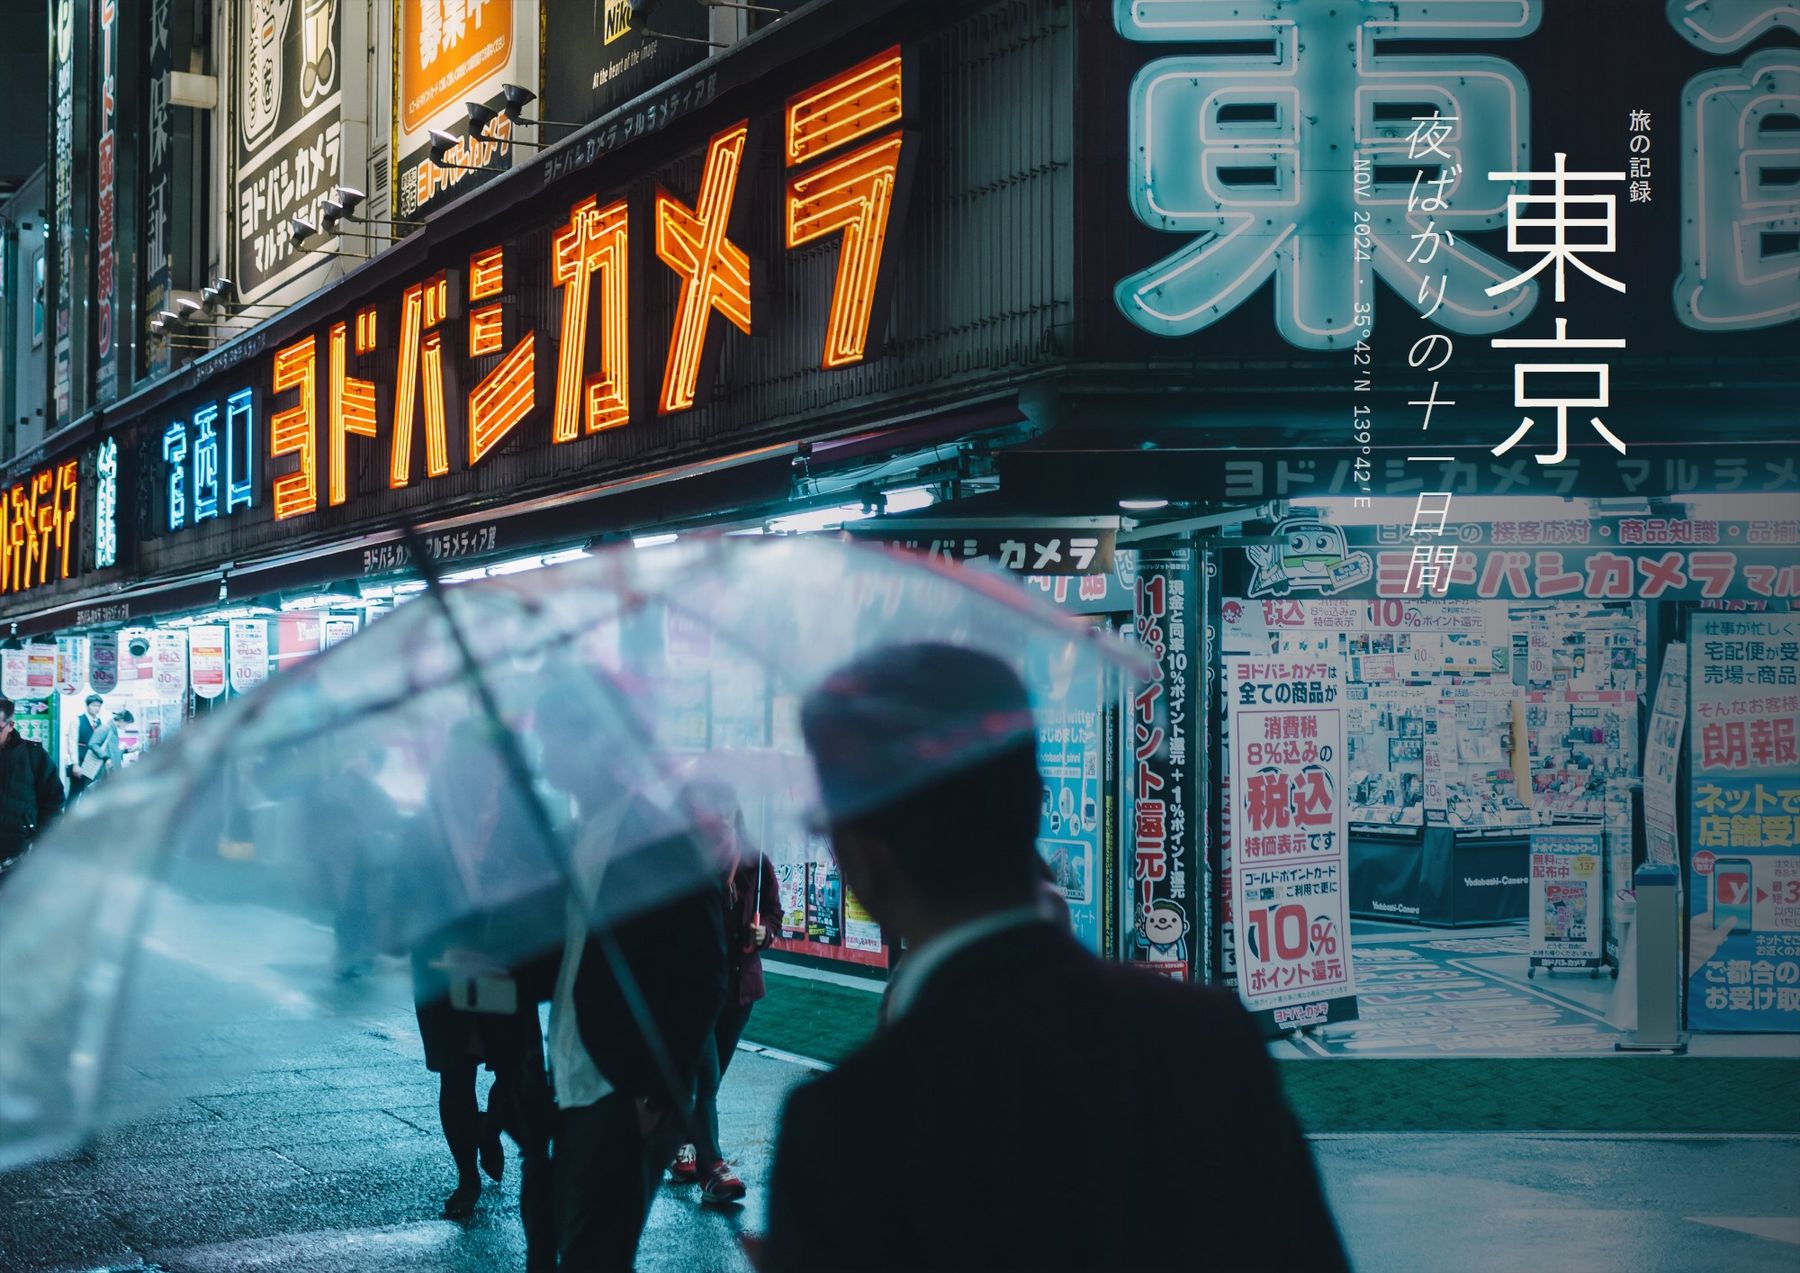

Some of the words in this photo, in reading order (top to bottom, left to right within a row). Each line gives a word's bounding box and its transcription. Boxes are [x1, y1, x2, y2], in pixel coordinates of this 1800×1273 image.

[608, 57, 623, 79] heart
[641, 40, 658, 63] image
[242, 121, 341, 240] ヨドバシカメラ
[271, 44, 903, 521] ヨドバシカメラ
[862, 538, 1098, 570] ドバシカメラ
[1705, 621, 1800, 636] 仕事が忙しく
[1704, 641, 1799, 661] 宅配便が受
[1238, 664, 1337, 679] ヨドバシカメラは
[1239, 681, 1337, 705] 全ての商品が
[1264, 715, 1317, 740] 消費税
[1247, 741, 1332, 766] 8%込みの
[1702, 719, 1798, 769] 朗報
[1247, 771, 1332, 832] 税込
[1695, 784, 1800, 814] ネットで
[1245, 831, 1335, 857] 特価表示です
[1698, 814, 1800, 847] 店舗受
[1245, 866, 1336, 886] ゴールドポイントカード
[1249, 904, 1337, 963] 10%
[1252, 958, 1342, 991] ポイント還元
[1706, 960, 1799, 985] ご都合の
